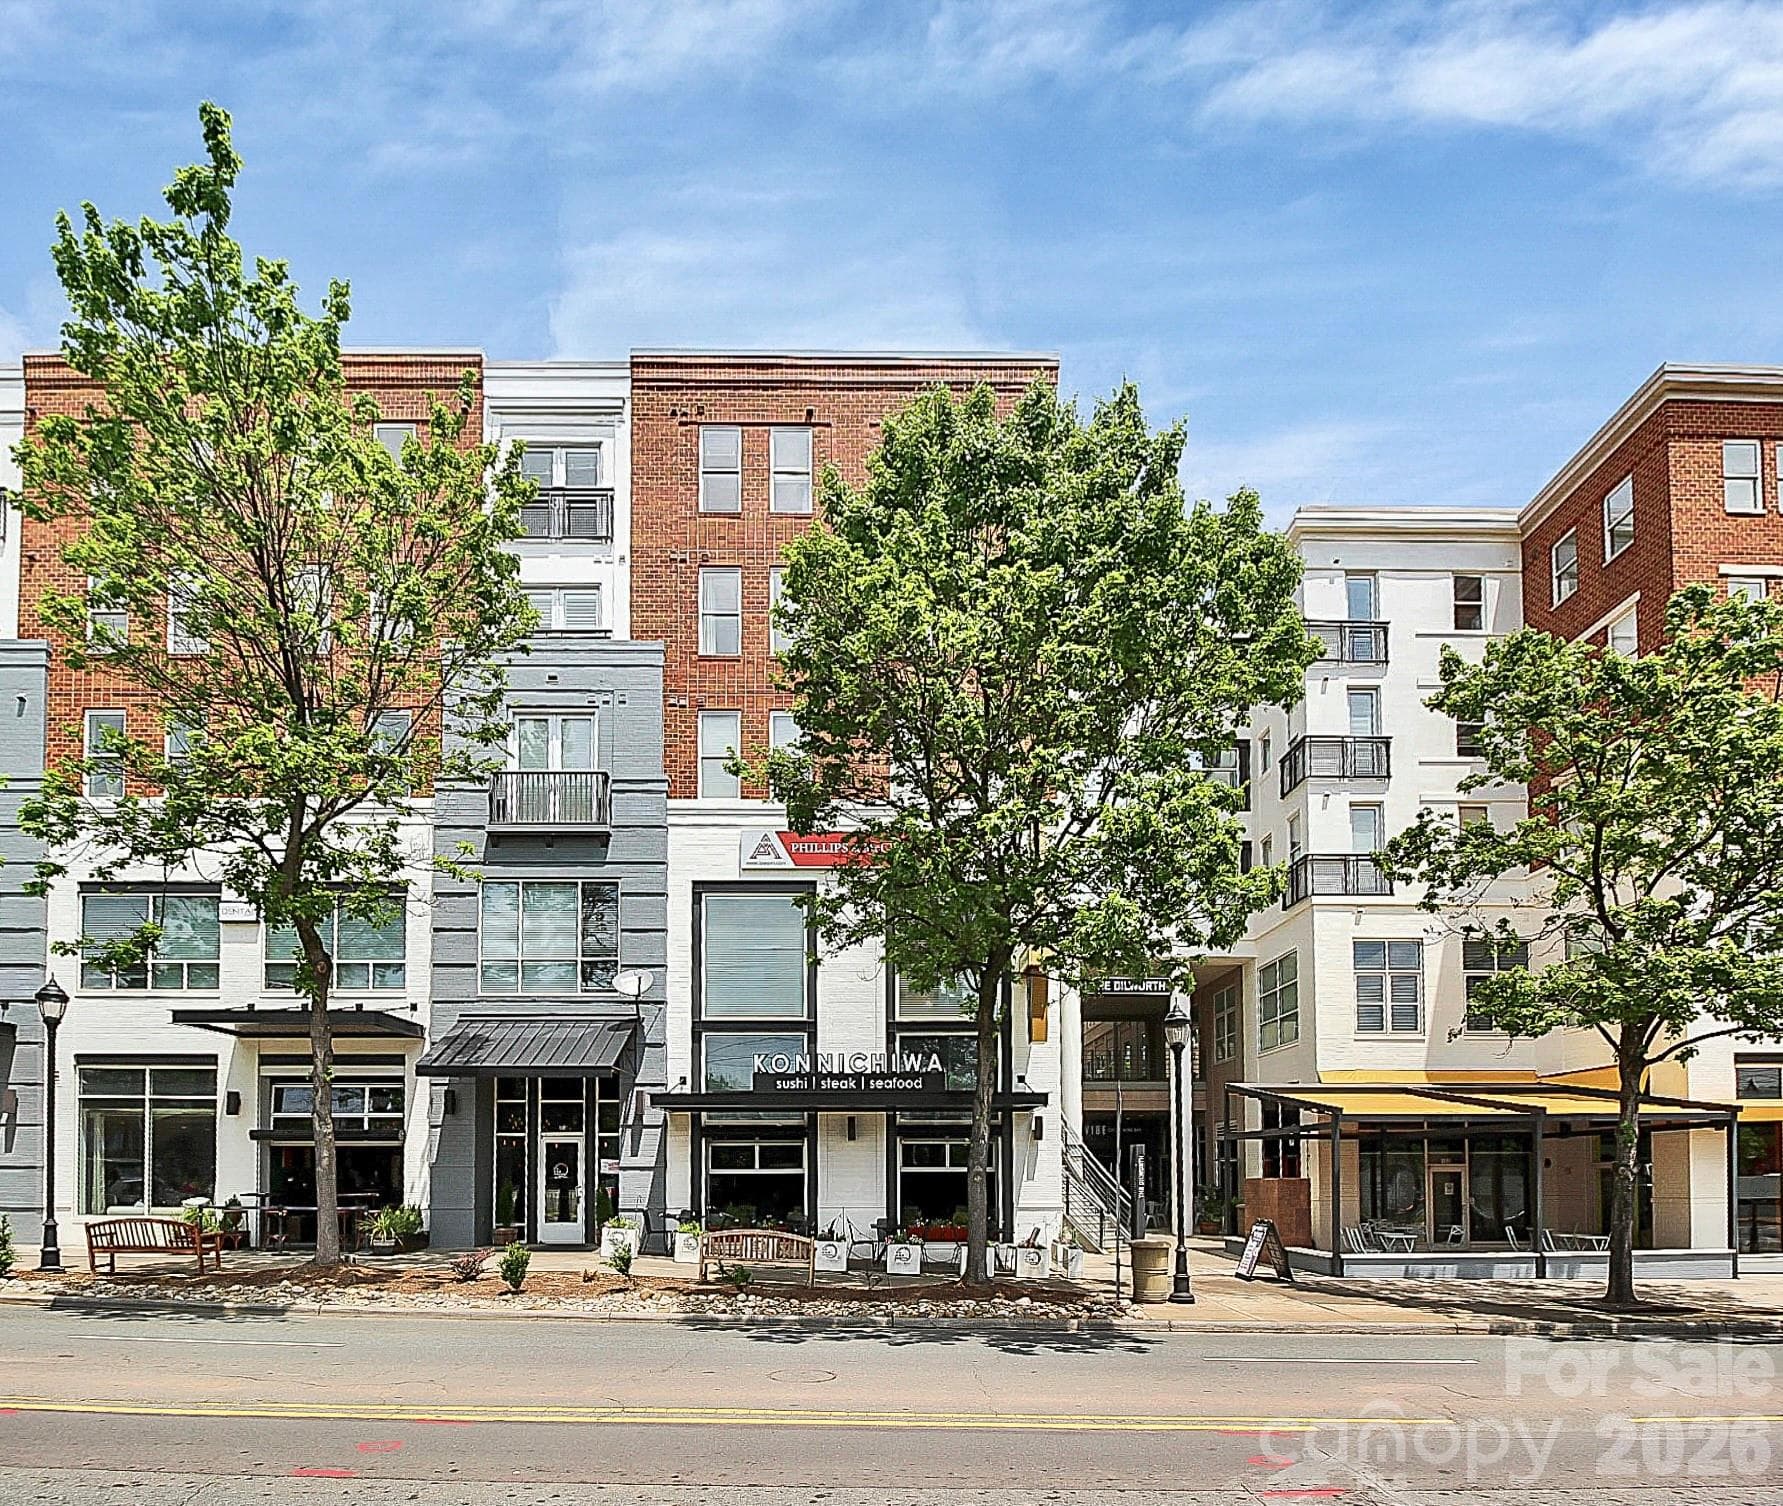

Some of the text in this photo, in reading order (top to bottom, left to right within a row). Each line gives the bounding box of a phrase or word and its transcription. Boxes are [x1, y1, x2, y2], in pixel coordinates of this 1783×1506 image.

[791, 842, 849, 854] PHILLIPS
[753, 1053, 944, 1074] KONNICHIWA
[776, 1077, 923, 1090] sushi steak seafood
